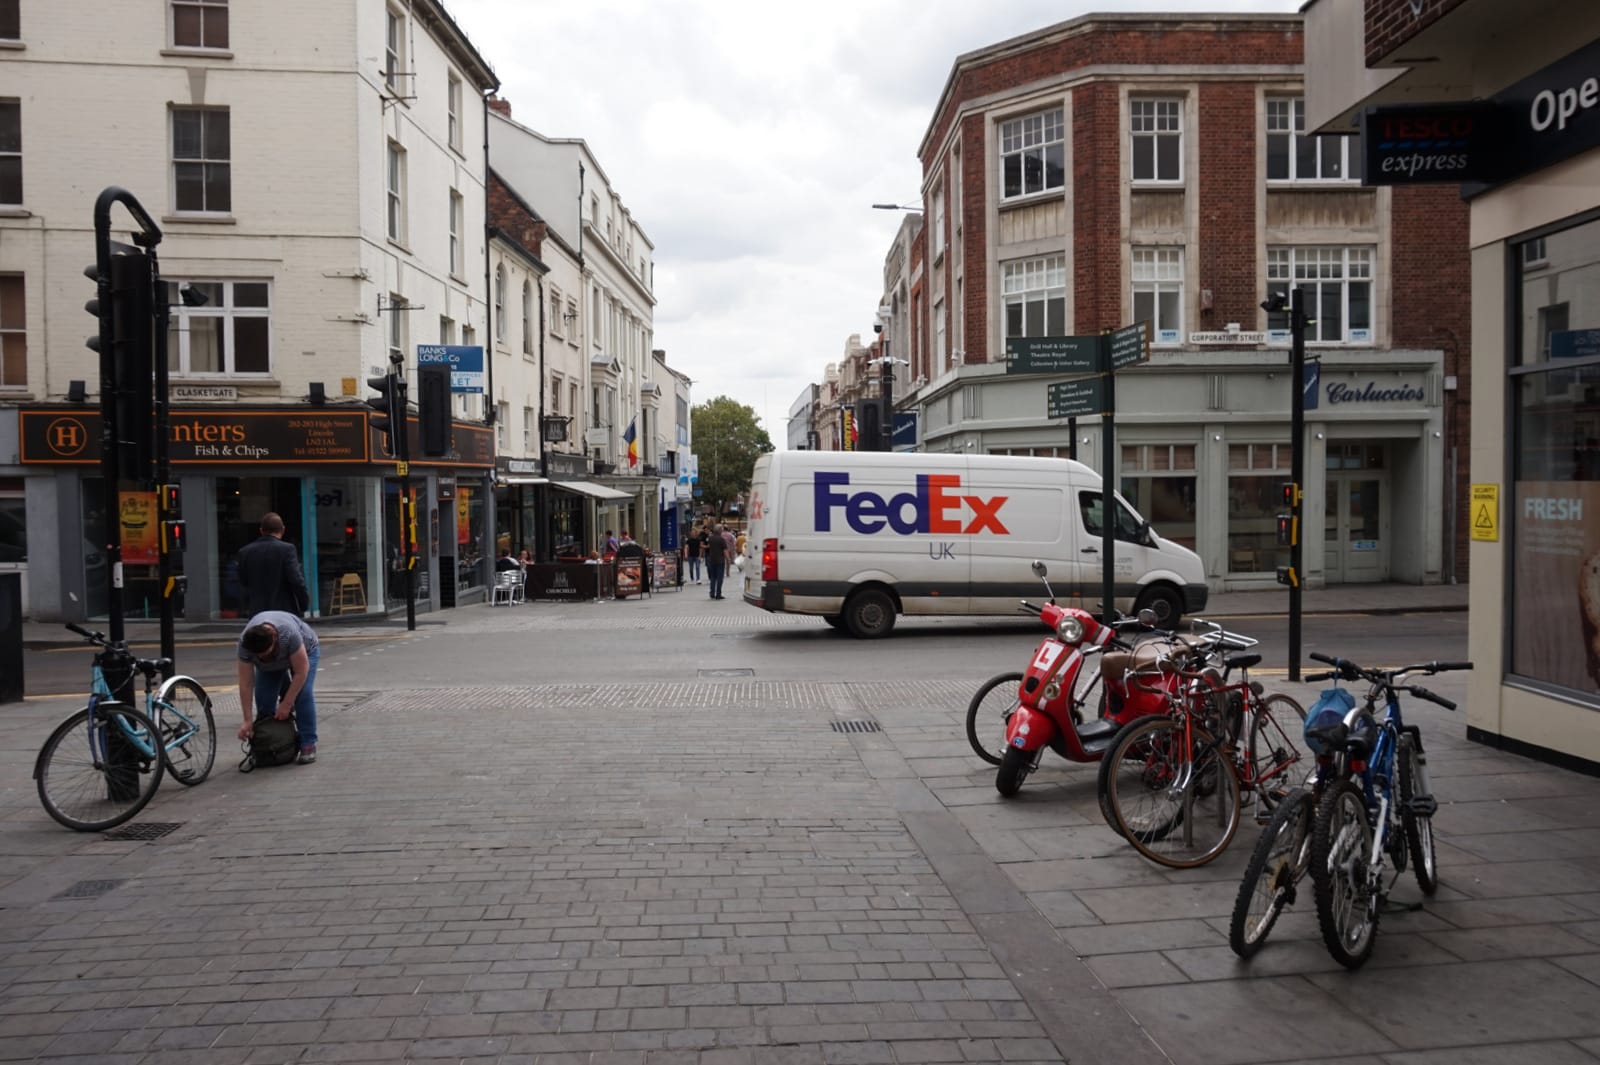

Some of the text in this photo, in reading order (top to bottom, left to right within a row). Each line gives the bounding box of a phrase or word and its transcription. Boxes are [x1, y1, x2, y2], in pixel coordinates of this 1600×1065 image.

[1379, 117, 1472, 139] TESCO
[1382, 153, 1467, 176] express
[1191, 334, 1239, 342] CORPORATION
[1240, 334, 1264, 342] STREET
[419, 346, 447, 355] BANKS
[452, 377, 470, 385] LET
[176, 388, 233, 397] CLASKETGATE
[55, 426, 78, 447] H
[171, 420, 246, 442] nters
[195, 445, 269, 459] Fish & Chips
[814, 471, 1010, 535] FedEx
[1525, 497, 1583, 520] FRESH
[929, 541, 956, 560] UK
[1039, 647, 1050, 664] L
